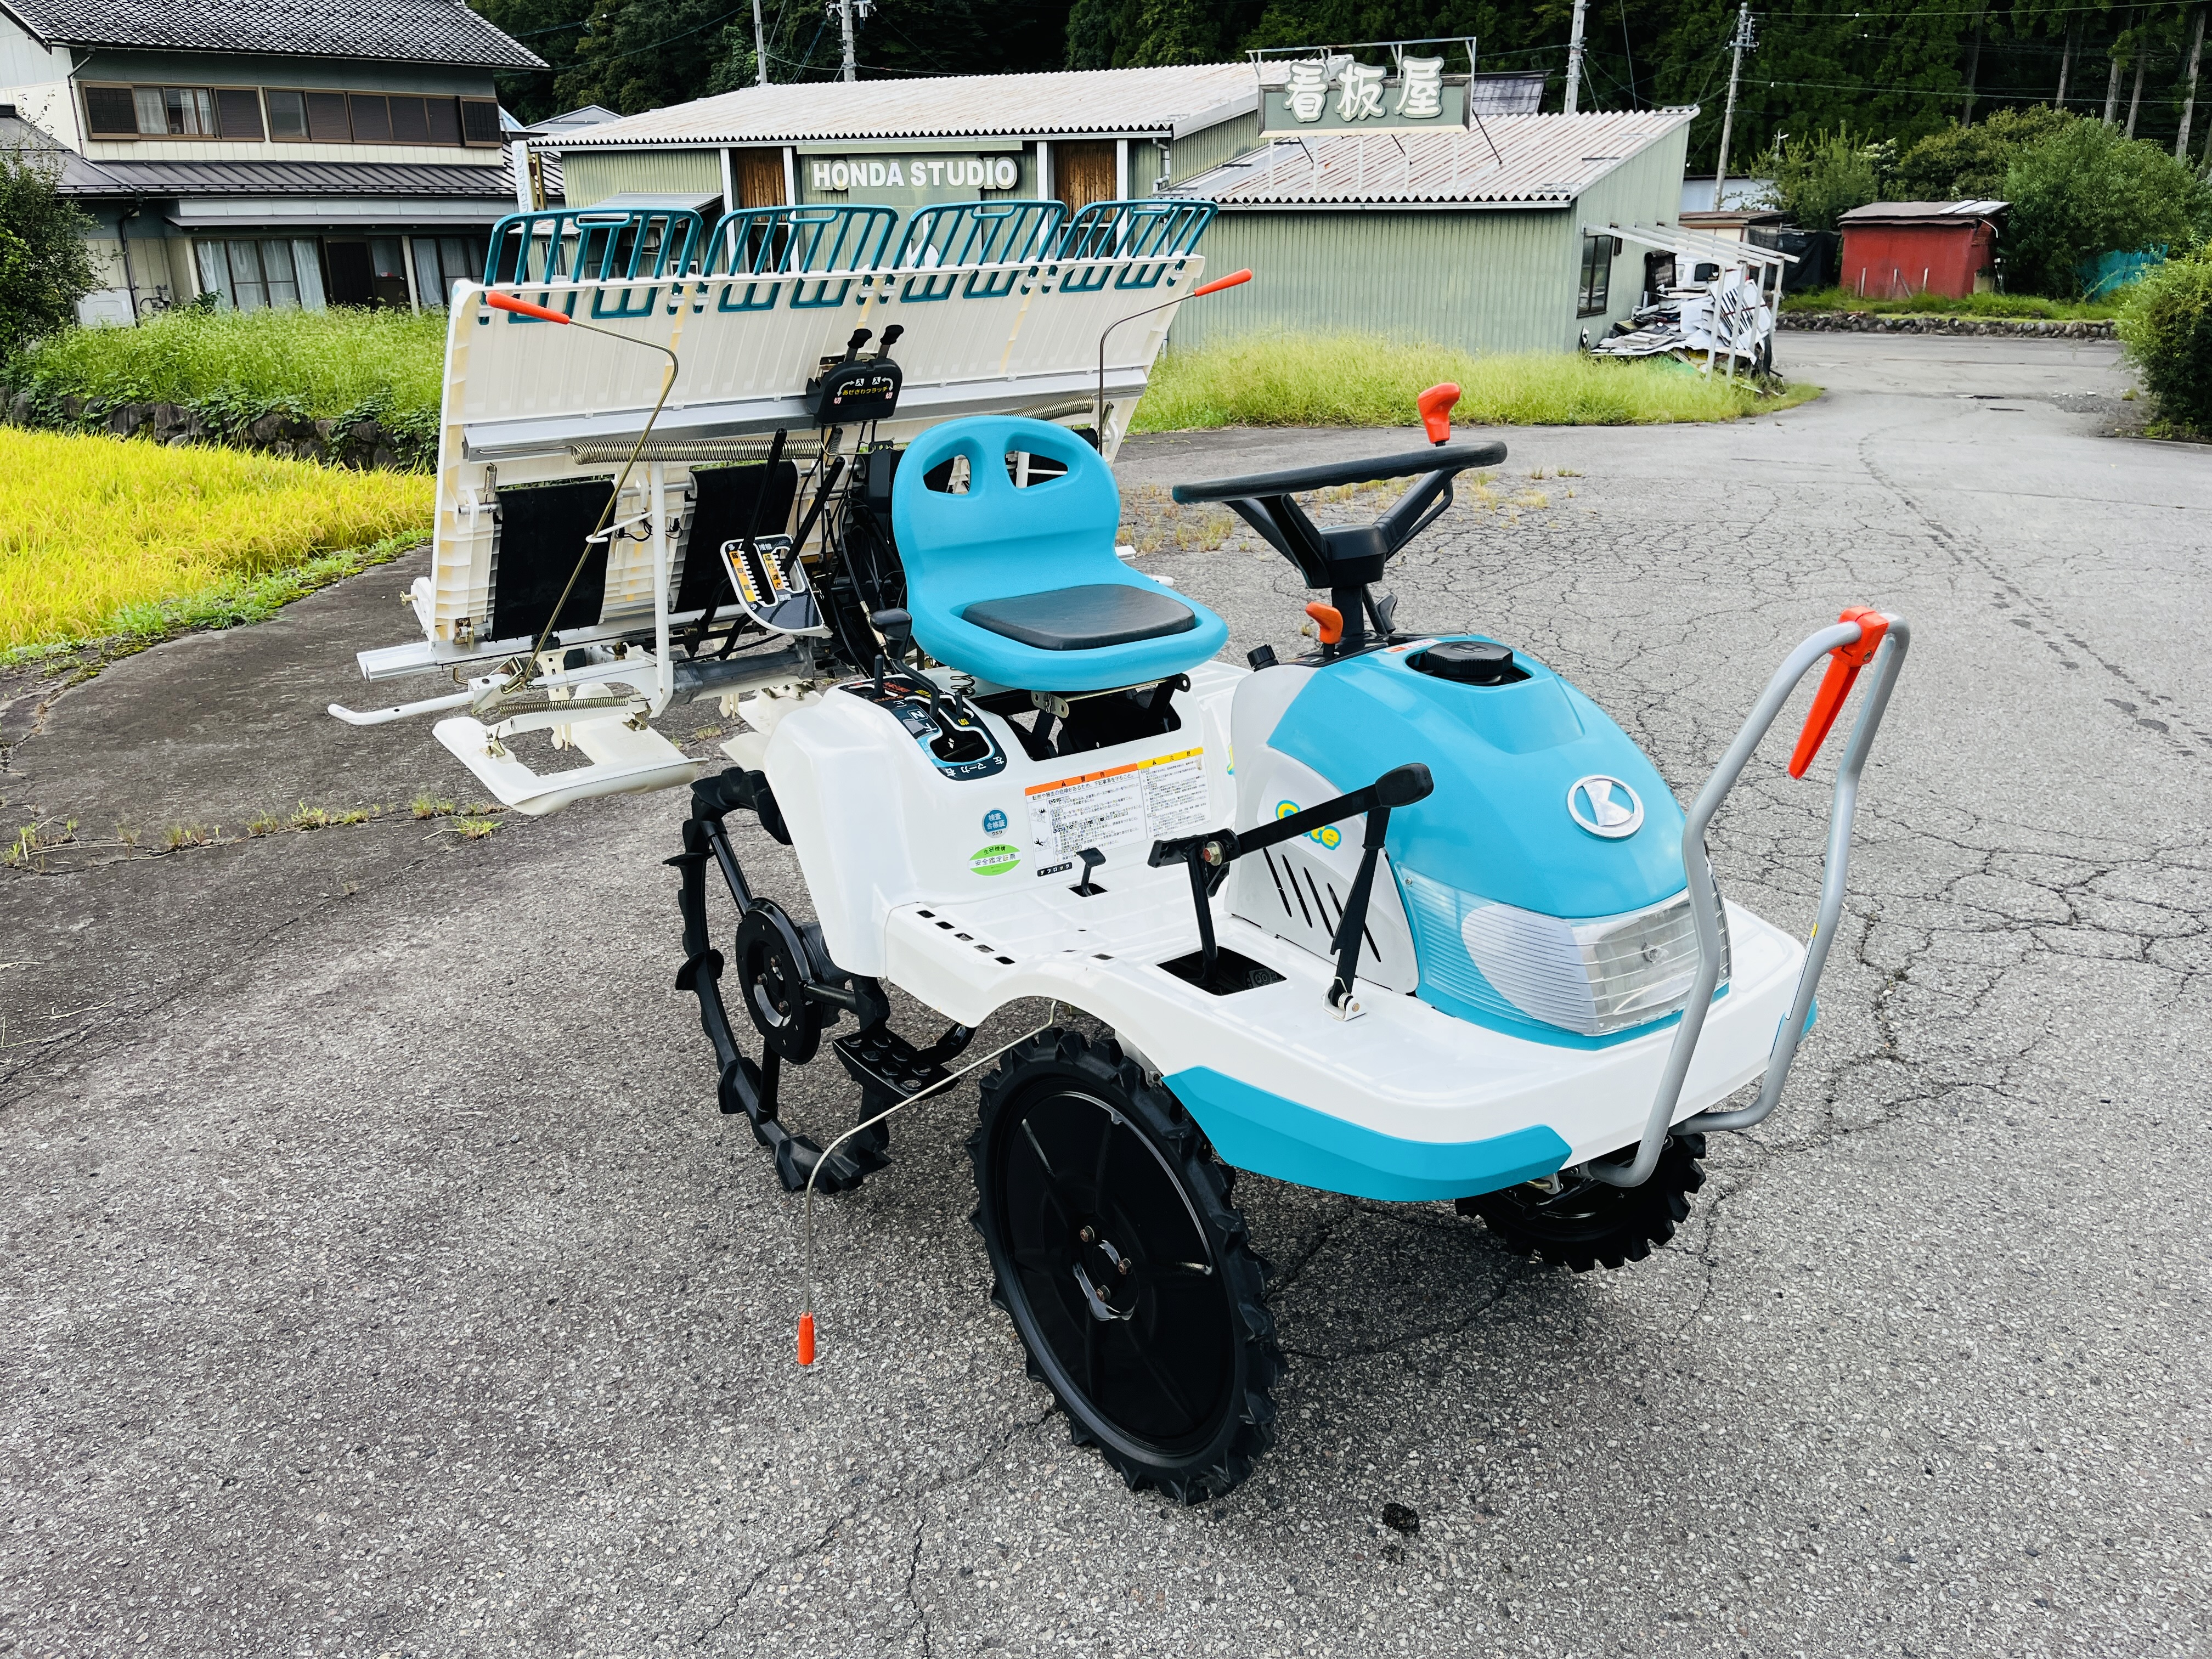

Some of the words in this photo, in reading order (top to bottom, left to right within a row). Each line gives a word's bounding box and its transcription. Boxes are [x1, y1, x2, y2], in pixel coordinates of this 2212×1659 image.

[1284, 57, 1443, 121] 看板屋
[812, 161, 905, 188] HONDA
[910, 158, 1017, 188] STUDIO
[912, 710, 924, 721] N
[960, 763, 986, 774] マーカ
[987, 811, 1002, 822] 検査
